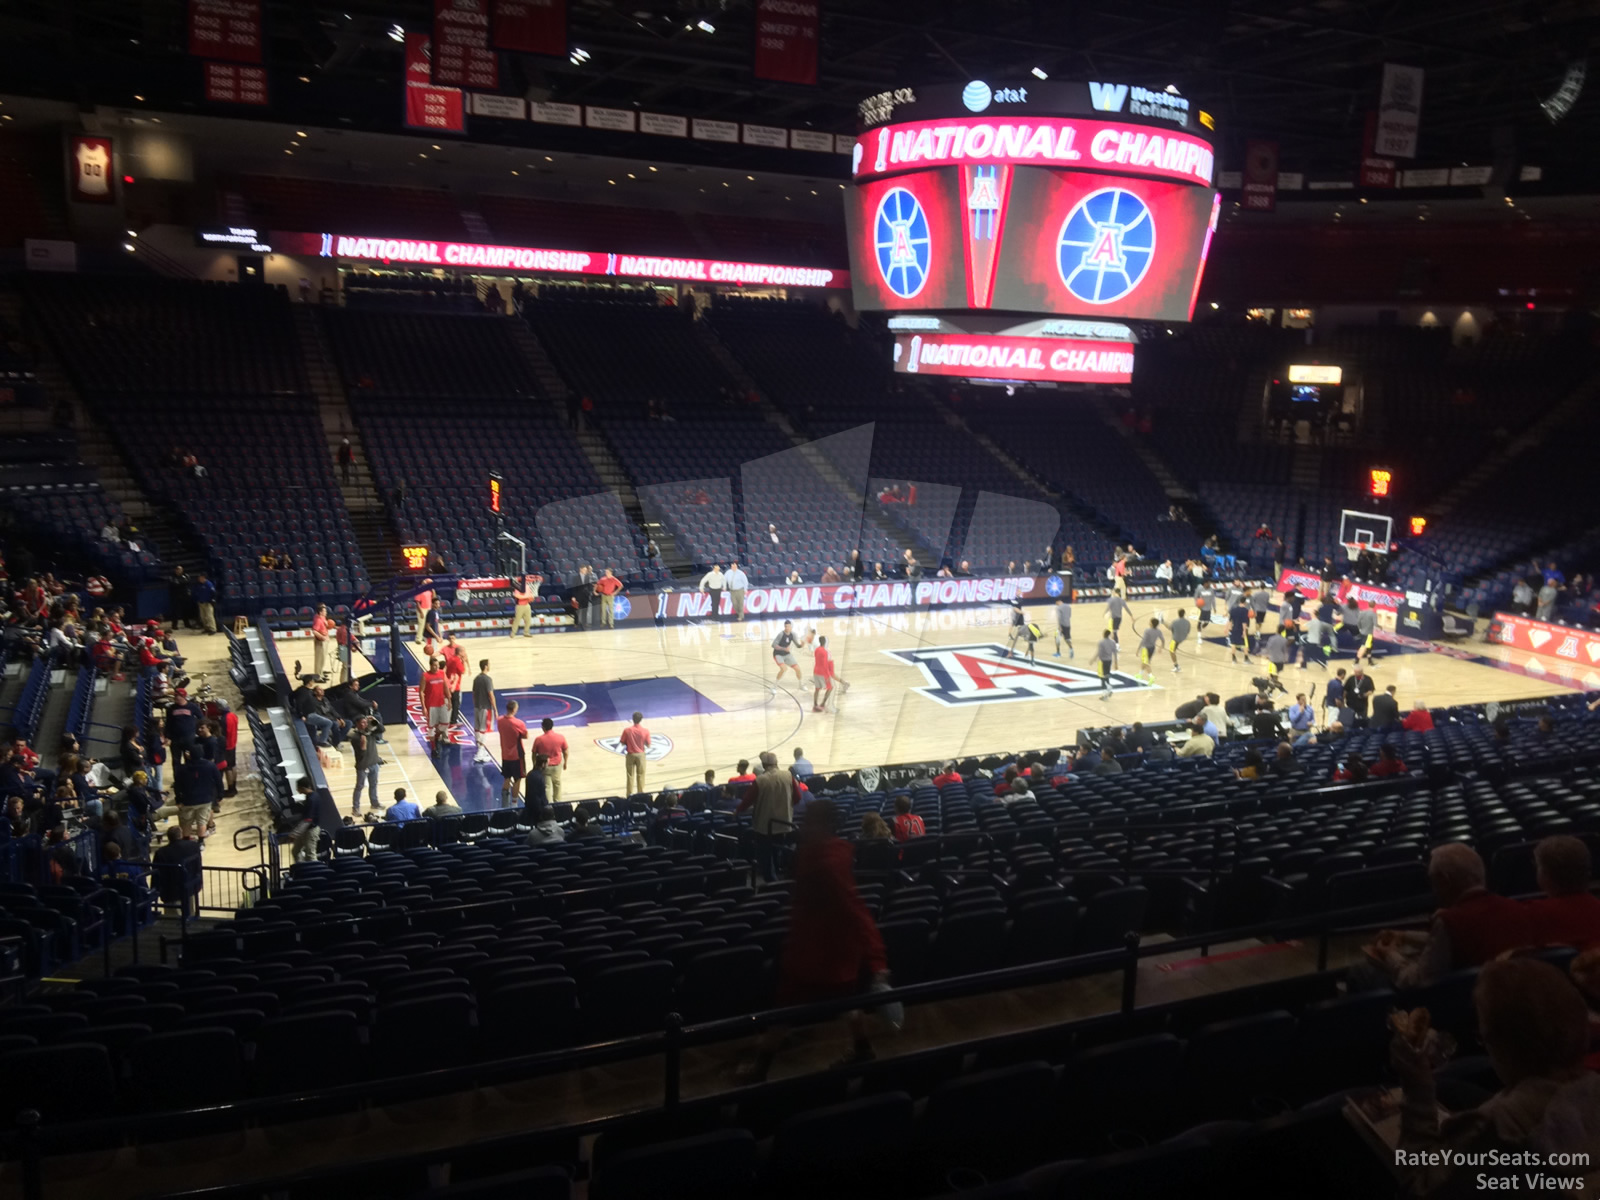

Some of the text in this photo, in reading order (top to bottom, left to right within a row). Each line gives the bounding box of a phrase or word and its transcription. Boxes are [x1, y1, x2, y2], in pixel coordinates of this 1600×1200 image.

[437, 9, 489, 27] ARIZON
[1130, 86, 1190, 111] Western
[1129, 100, 1189, 127] Refining
[890, 124, 1082, 163] NATIONAL
[337, 236, 442, 263] NATIONAL
[444, 244, 591, 272] CHAMPIONSHIP
[620, 256, 707, 280] NATIONAL
[709, 264, 833, 287] CHAMPIONSHIP
[920, 343, 1045, 370] NATIONAL
[470, 591, 514, 599] NETWOR
[677, 587, 825, 617] NATONAL
[833, 577, 1035, 609] CHAMPIONSHIP
[881, 767, 945, 781] NETWRK
